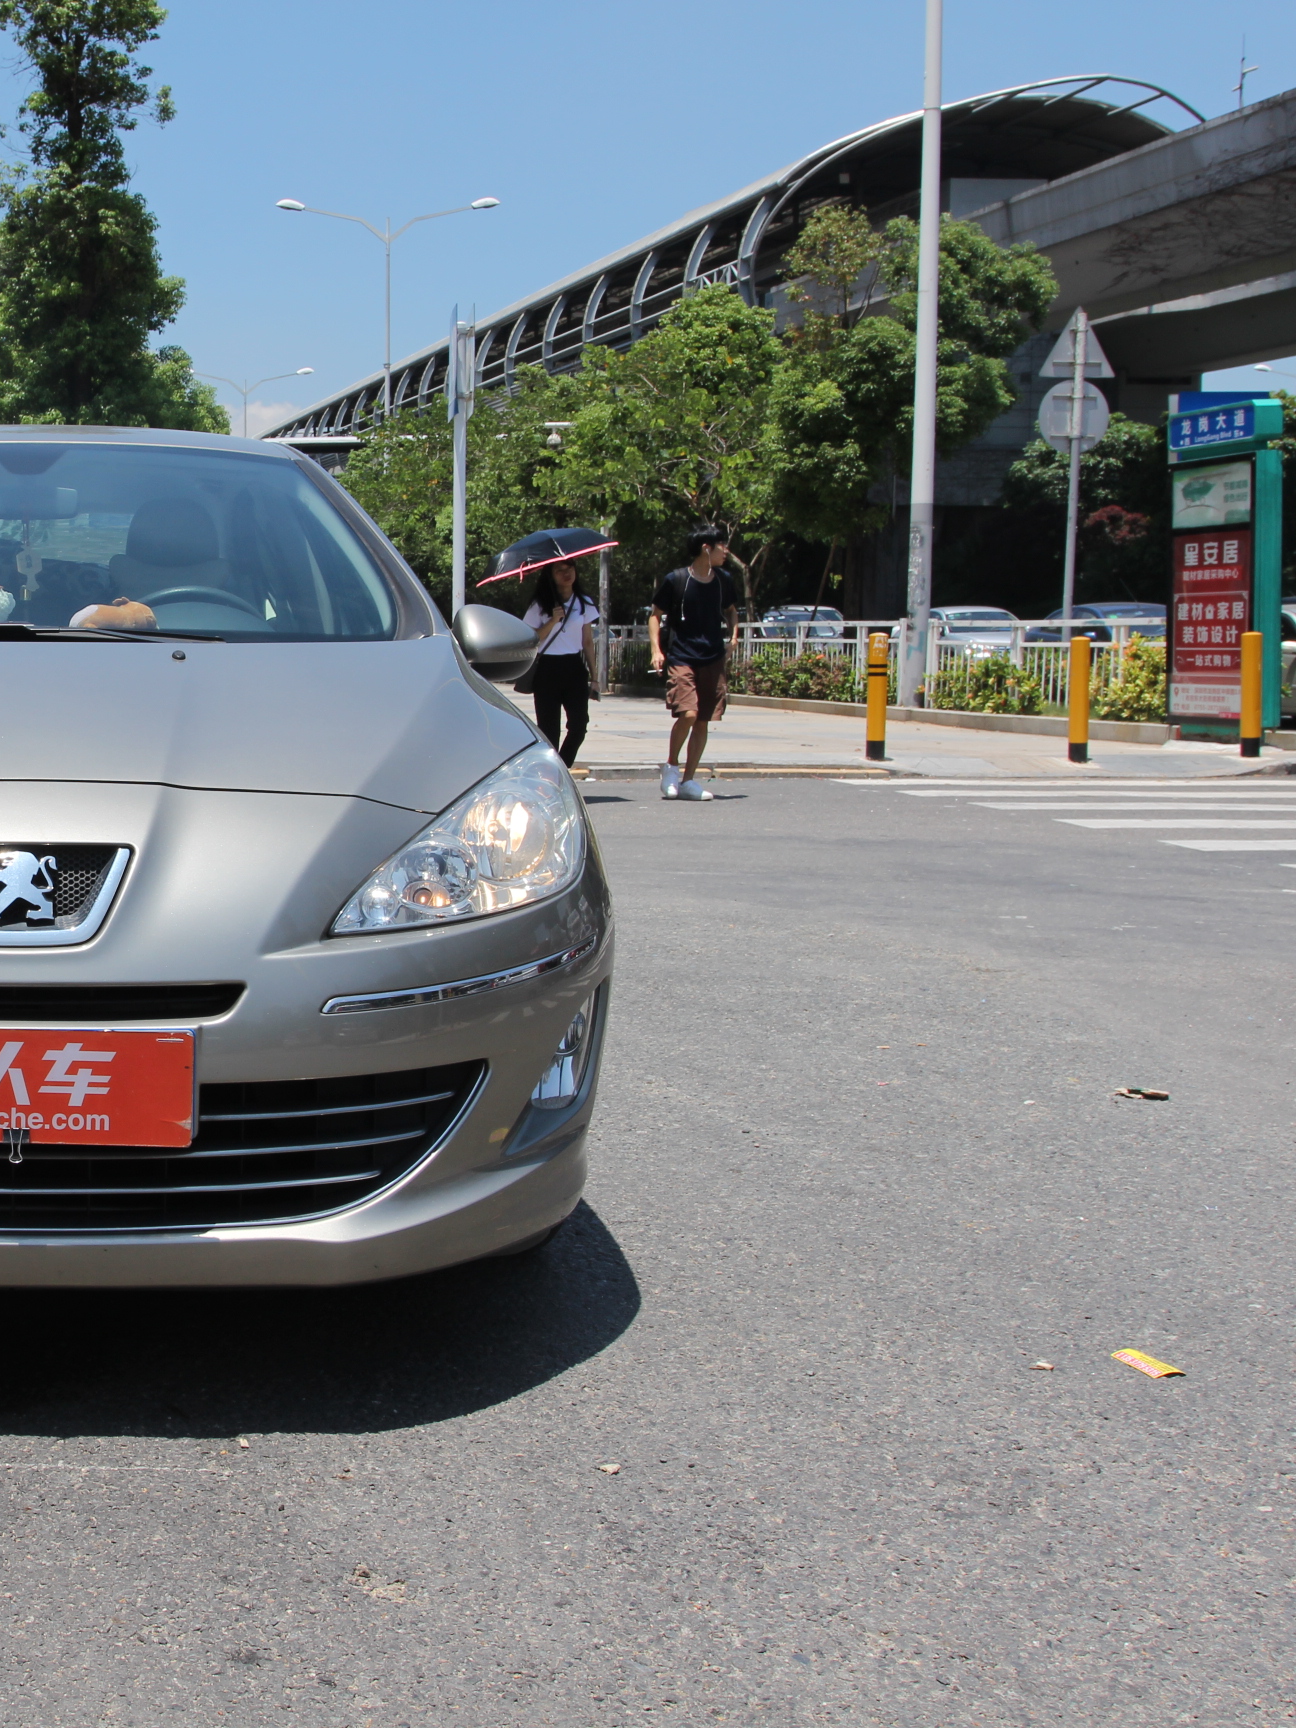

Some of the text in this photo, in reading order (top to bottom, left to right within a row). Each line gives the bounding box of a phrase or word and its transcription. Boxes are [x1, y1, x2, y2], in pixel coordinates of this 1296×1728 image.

[1181, 409, 1246, 435] 龙岗大道
[1184, 540, 1239, 566] 星安居
[1182, 625, 1239, 645] 装饰设计
